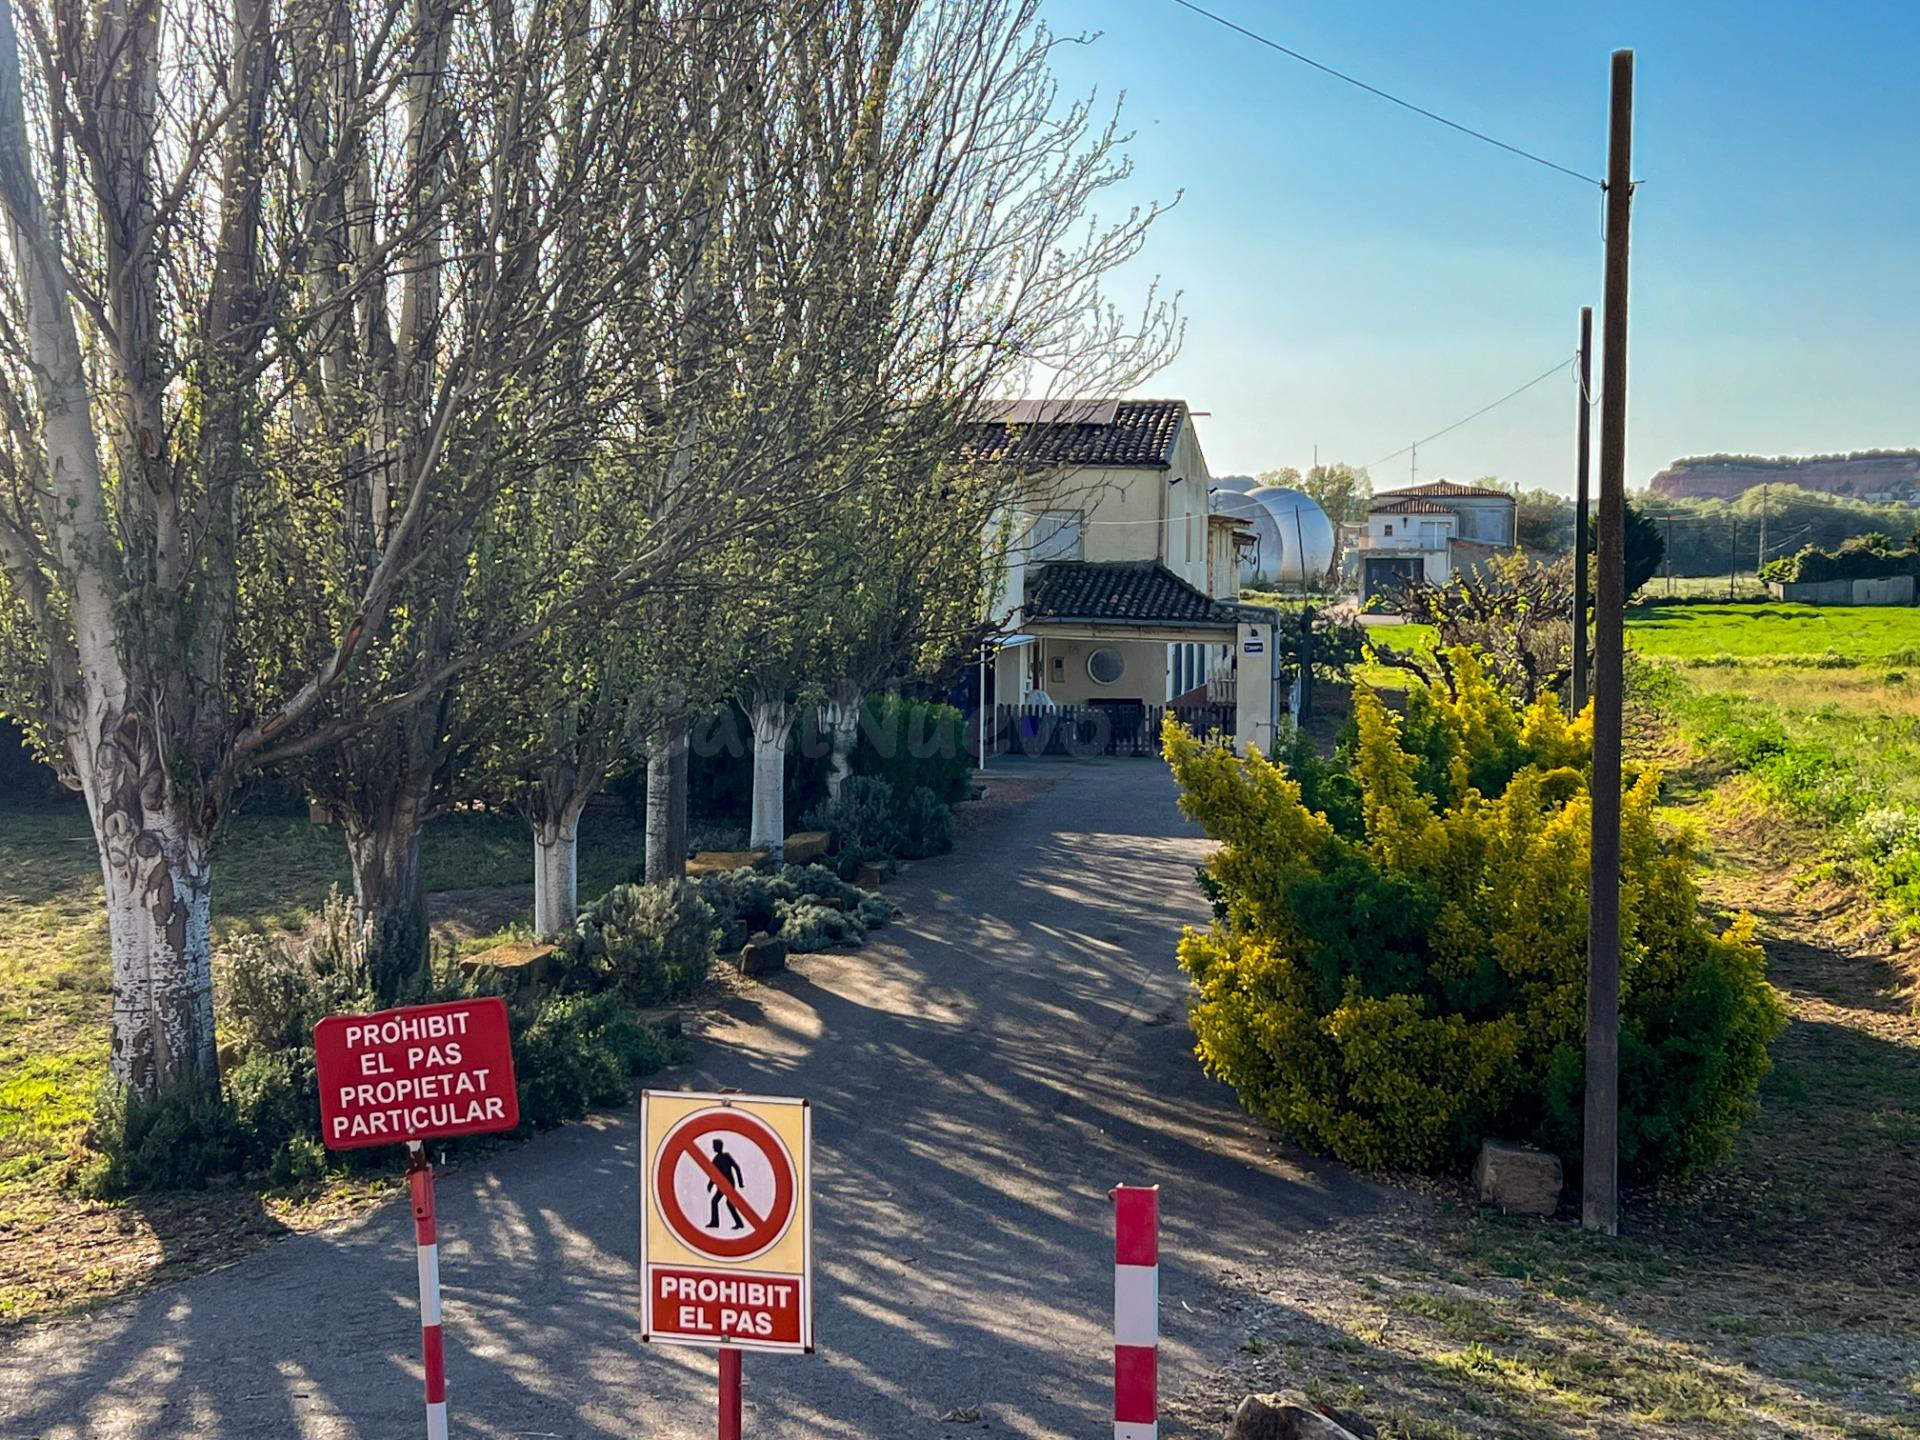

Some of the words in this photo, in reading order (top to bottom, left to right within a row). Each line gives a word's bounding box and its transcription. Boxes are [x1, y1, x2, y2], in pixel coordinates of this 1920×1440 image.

[346, 1012, 470, 1048] PROHIBIT
[360, 1052, 394, 1076] EL
[407, 1043, 462, 1070] PAS
[340, 1068, 489, 1109] PROPIETAT
[333, 1097, 505, 1139] PARTICULAR
[661, 1276, 792, 1309] PROHIBIT
[679, 1306, 713, 1330] EL
[720, 1308, 773, 1335] PAS
